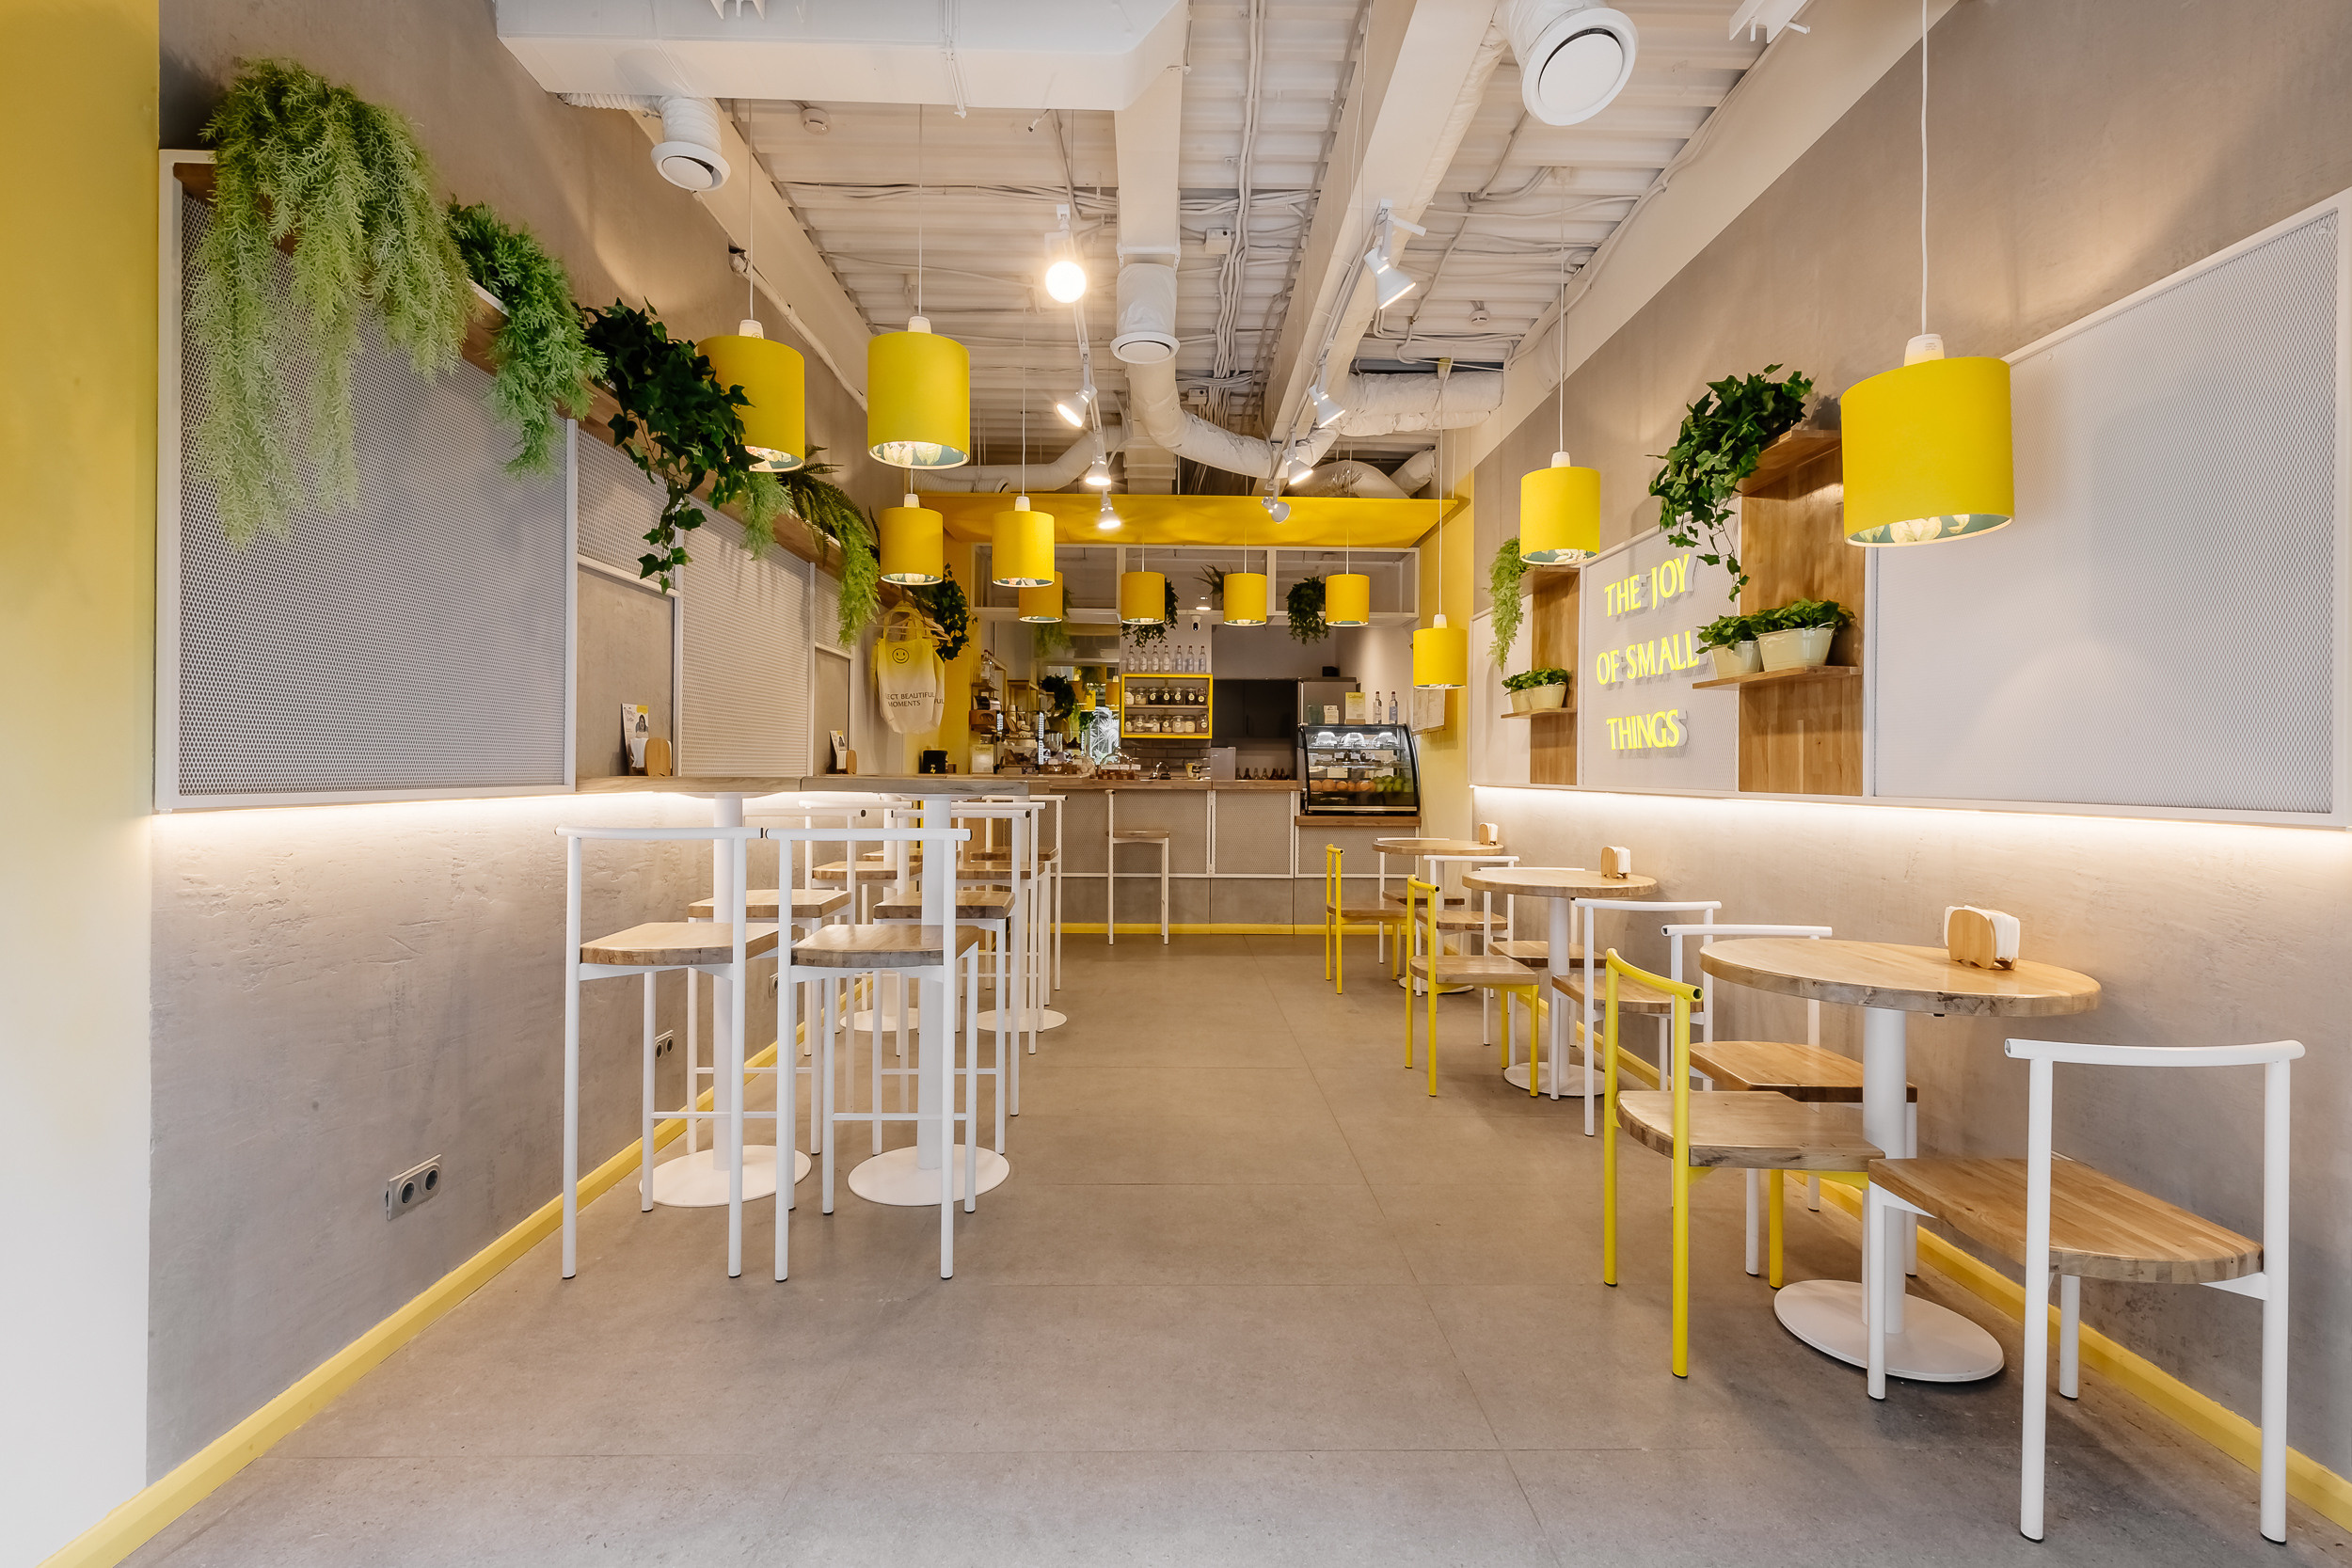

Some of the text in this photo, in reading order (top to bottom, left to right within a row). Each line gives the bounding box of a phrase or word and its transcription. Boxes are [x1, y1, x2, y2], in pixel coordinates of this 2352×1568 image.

[1604, 553, 1690, 617] THE JOY
[1597, 629, 1700, 686] OF SMALL
[888, 699, 921, 707] MOMENTS
[901, 691, 935, 700] BEAUTIFUL
[1605, 708, 1680, 751] THINGS
